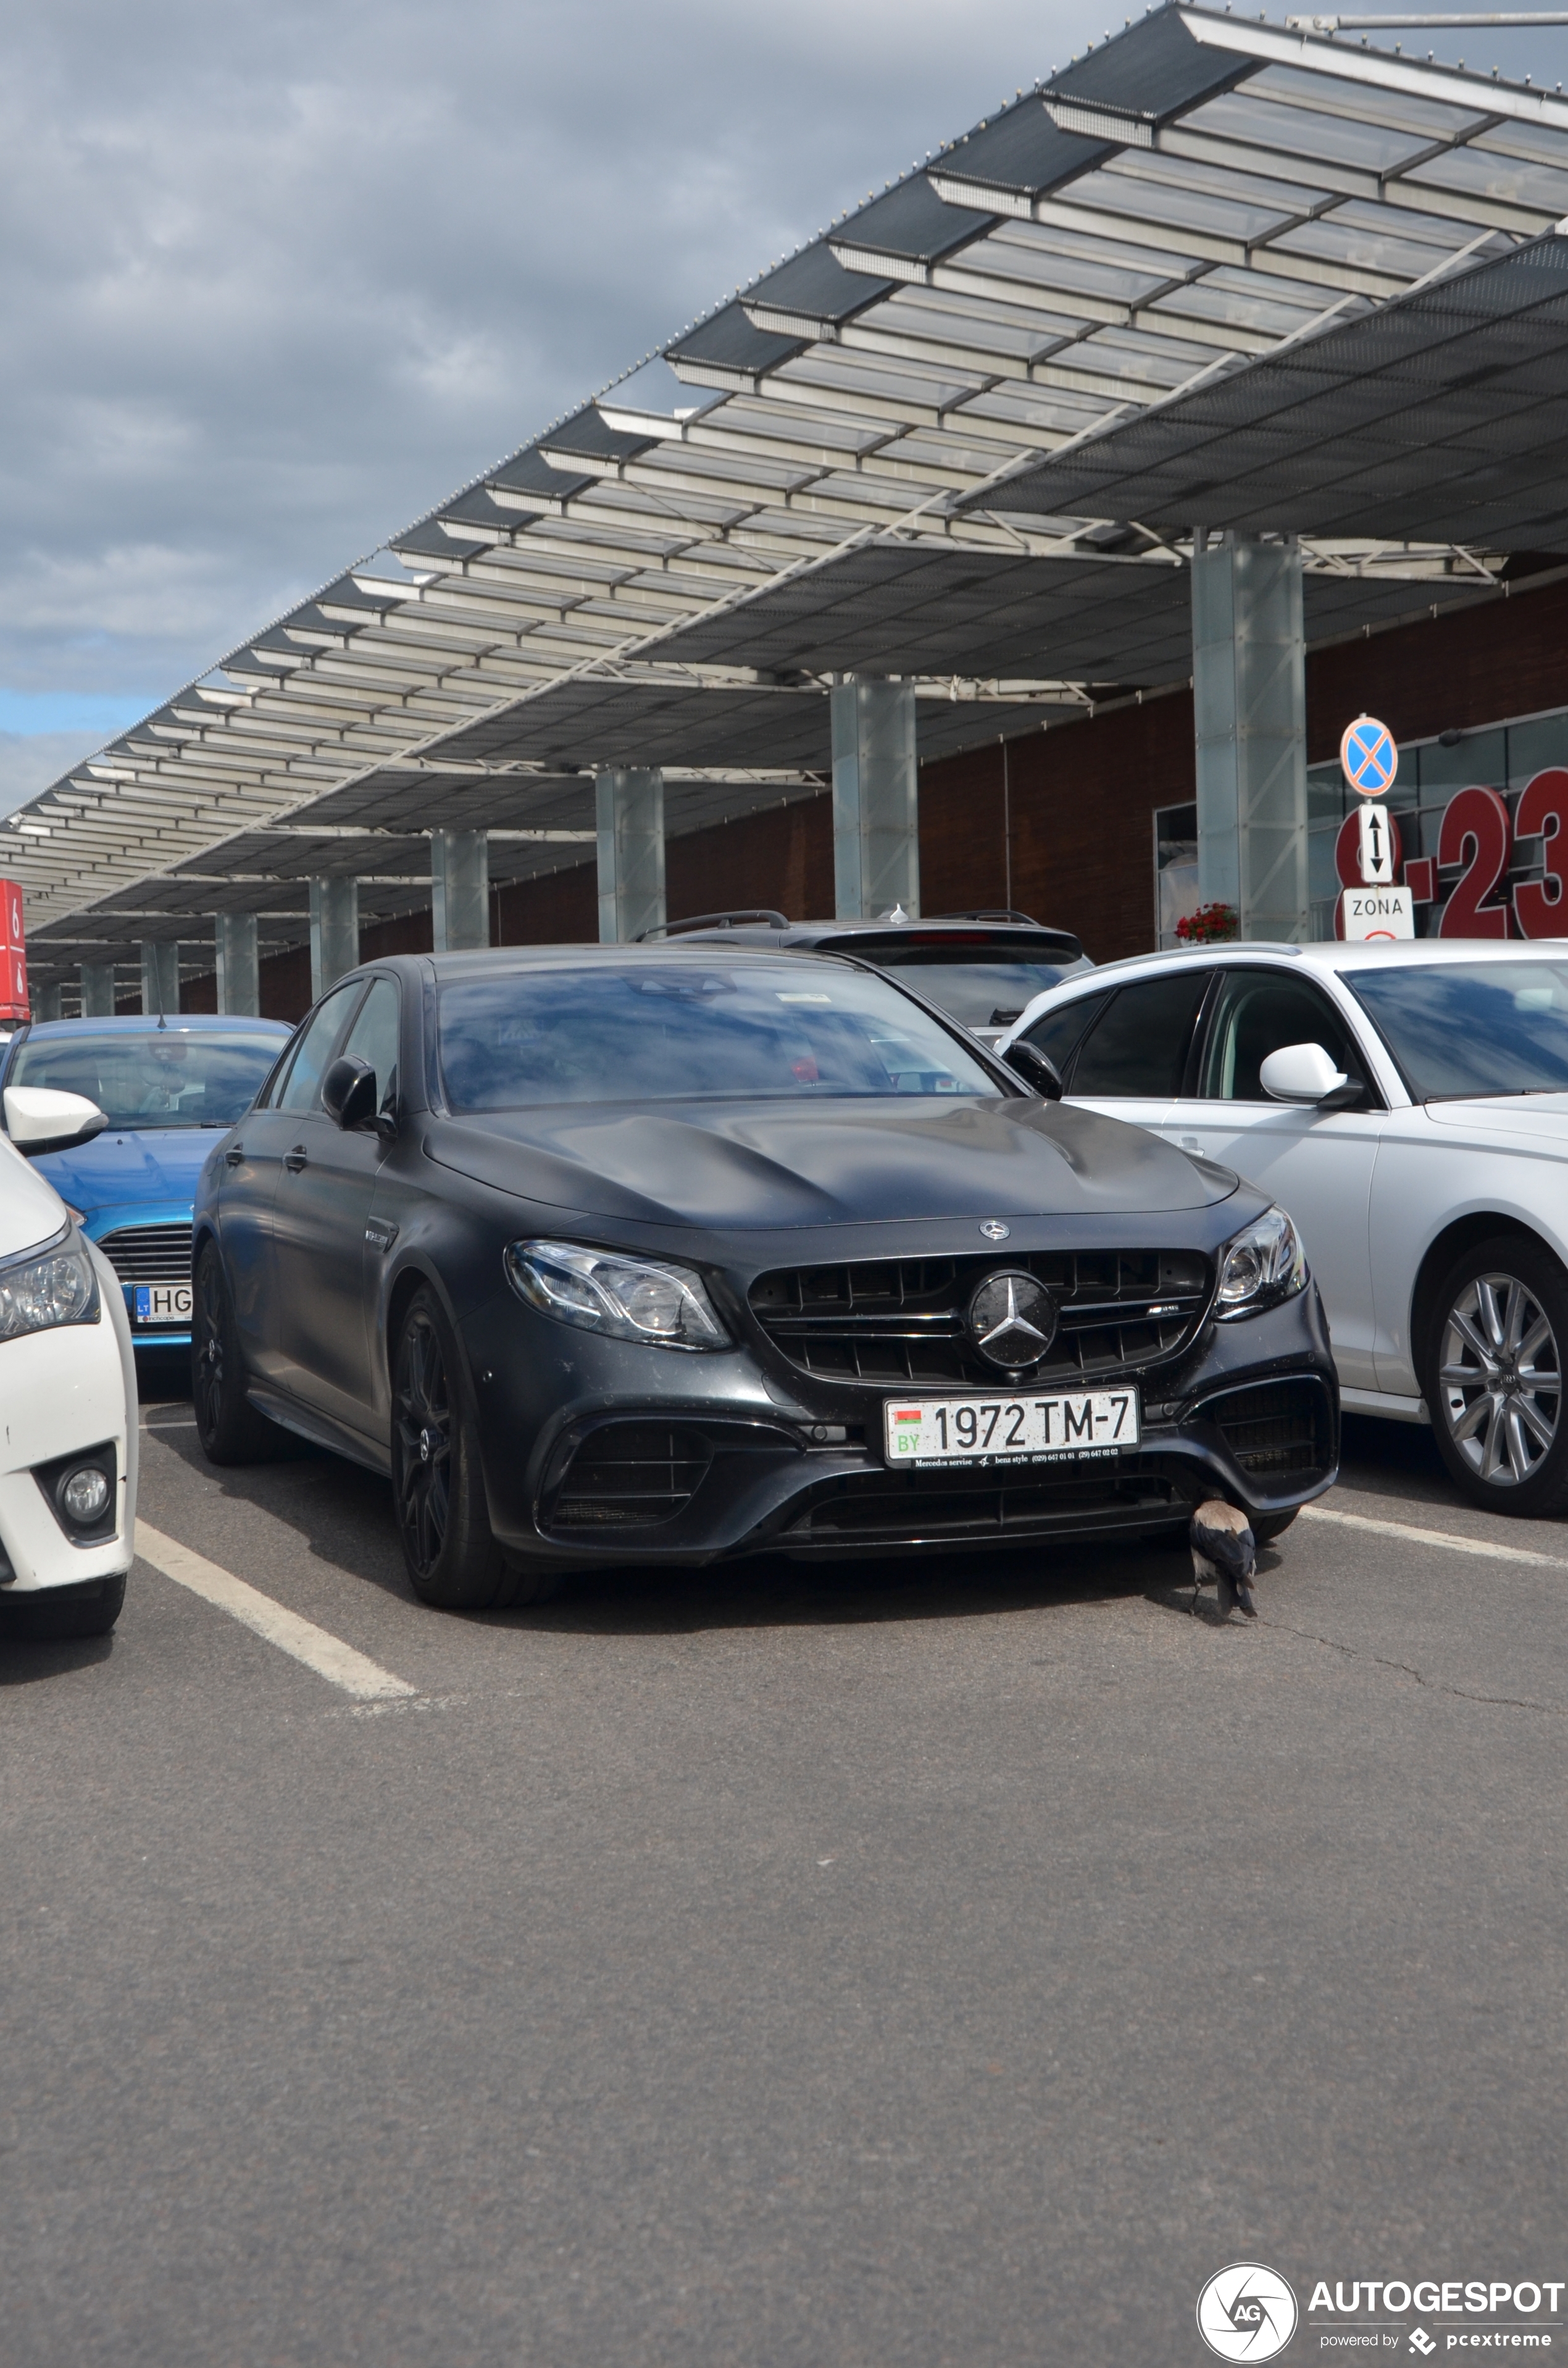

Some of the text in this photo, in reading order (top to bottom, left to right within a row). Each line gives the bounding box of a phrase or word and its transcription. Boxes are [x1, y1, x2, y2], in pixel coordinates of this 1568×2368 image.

[1353, 898, 1403, 916] ZONA
[12, 898, 19, 939] 6
[154, 1289, 191, 1313] HG
[935, 1396, 1128, 1450] 1972 TM-7
[898, 1434, 920, 1452] BY
[915, 1458, 948, 1467] Mercedes
[1012, 1455, 1028, 1464] style
[1032, 1455, 1047, 1463] (029)
[1078, 1452, 1090, 1460] (29)
